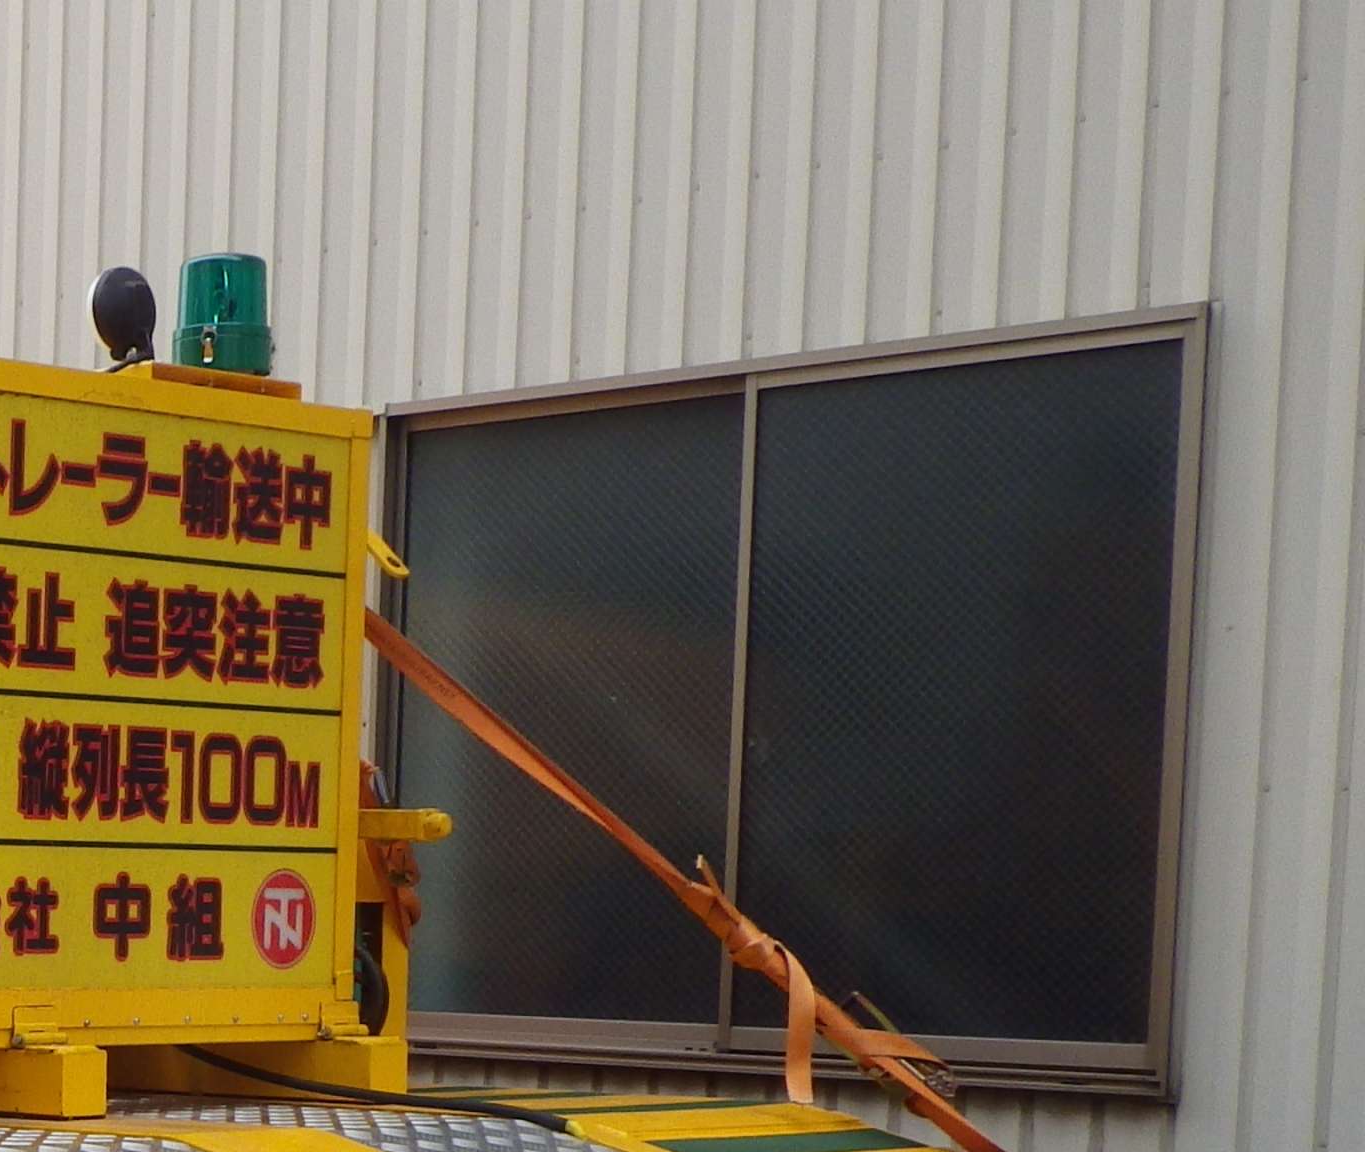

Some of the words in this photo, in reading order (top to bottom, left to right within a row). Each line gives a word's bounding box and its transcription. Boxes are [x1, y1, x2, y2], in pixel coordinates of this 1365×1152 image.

[104, 578, 325, 690] 追突注意
[18, 717, 320, 829] 縦列長100M
